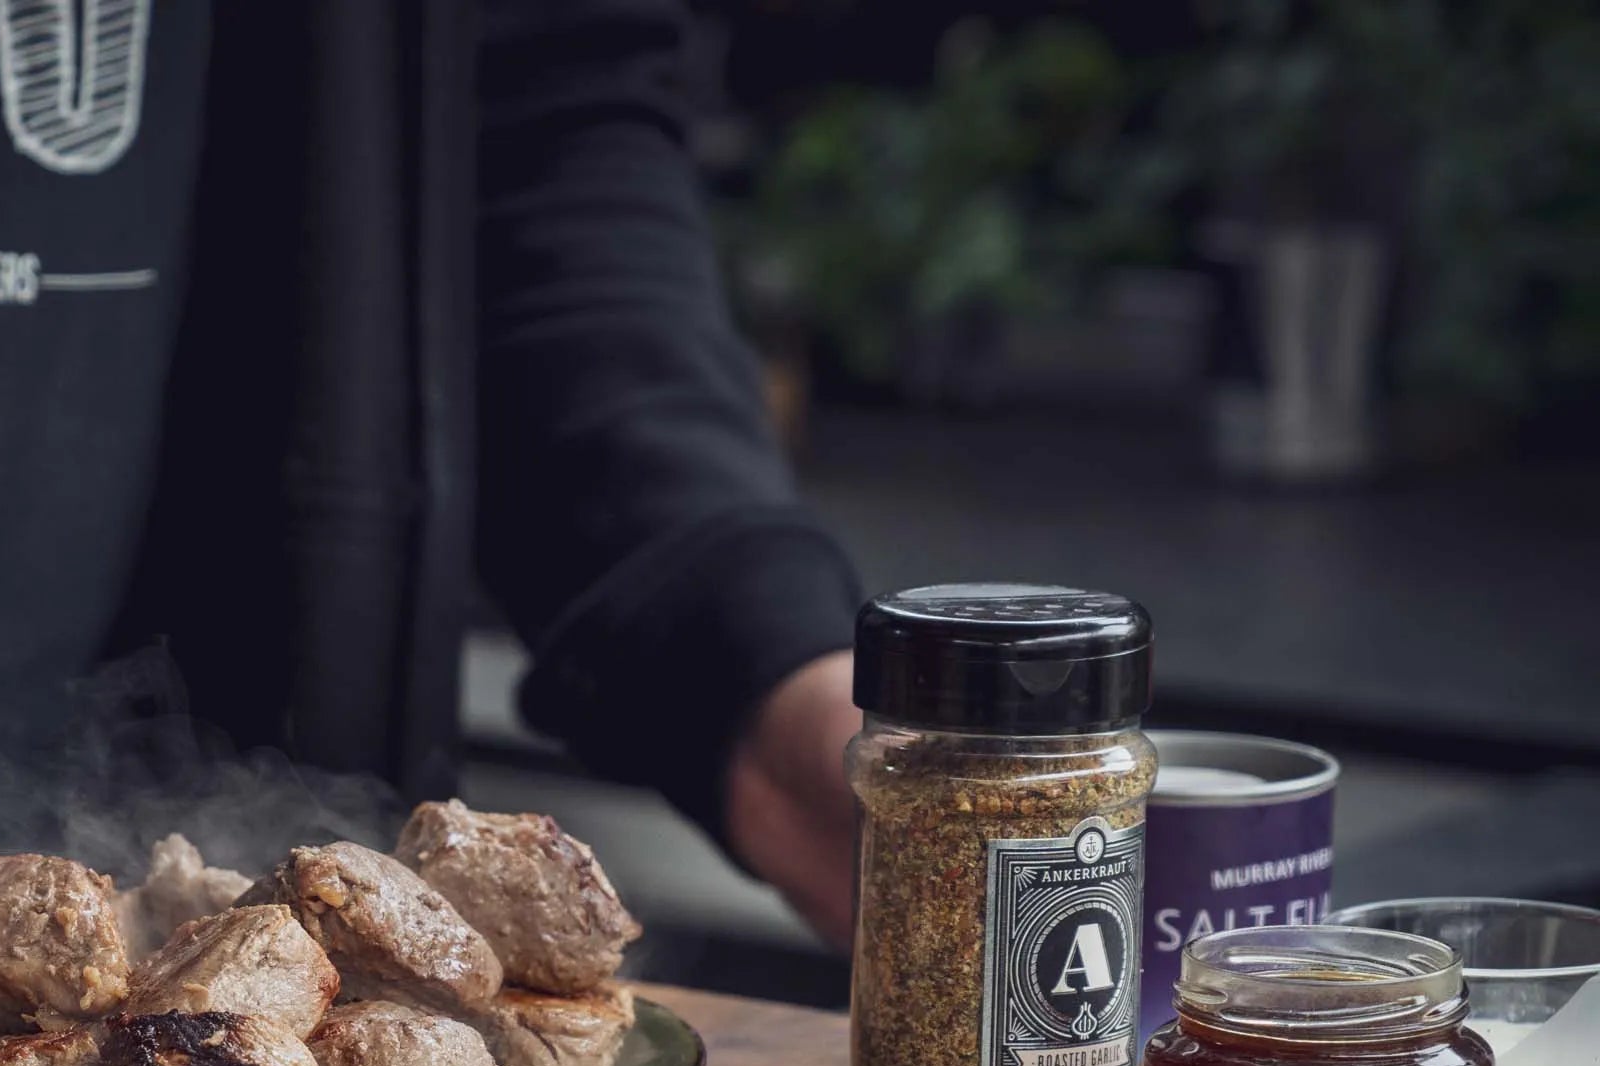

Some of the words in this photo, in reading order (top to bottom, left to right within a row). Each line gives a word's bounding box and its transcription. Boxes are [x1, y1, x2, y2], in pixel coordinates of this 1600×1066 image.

[1041, 861, 1126, 883] ANKERKRAUT
[1211, 857, 1295, 890] MURRAY
[1051, 923, 1114, 994] A
